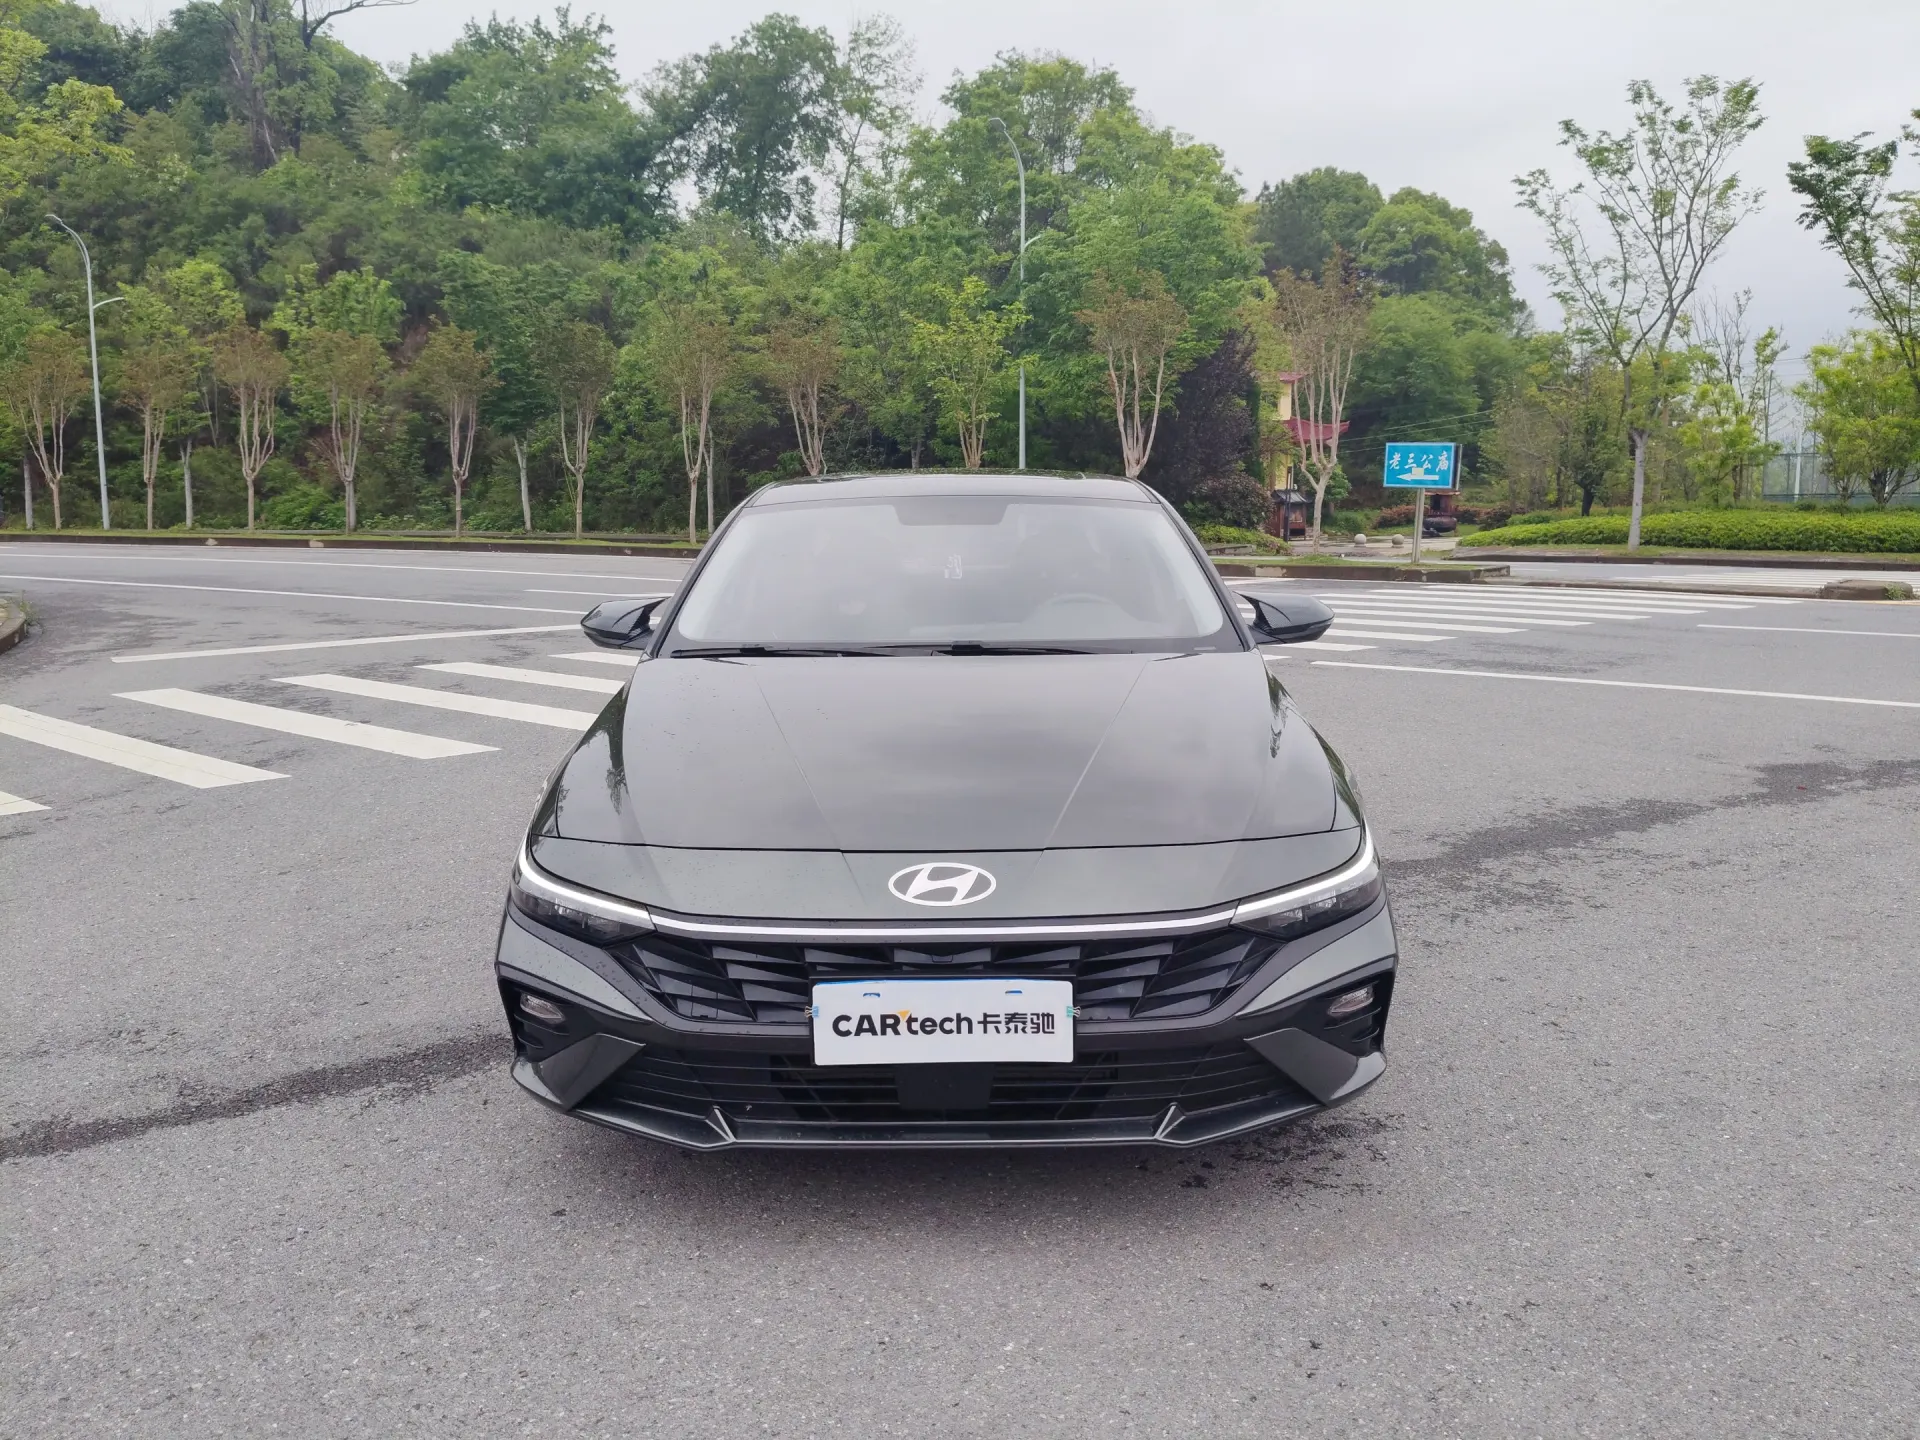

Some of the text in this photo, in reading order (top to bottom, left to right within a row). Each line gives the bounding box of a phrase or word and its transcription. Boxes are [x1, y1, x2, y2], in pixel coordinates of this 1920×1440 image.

[832, 1011, 1055, 1037] CARtech 卡泰驰
